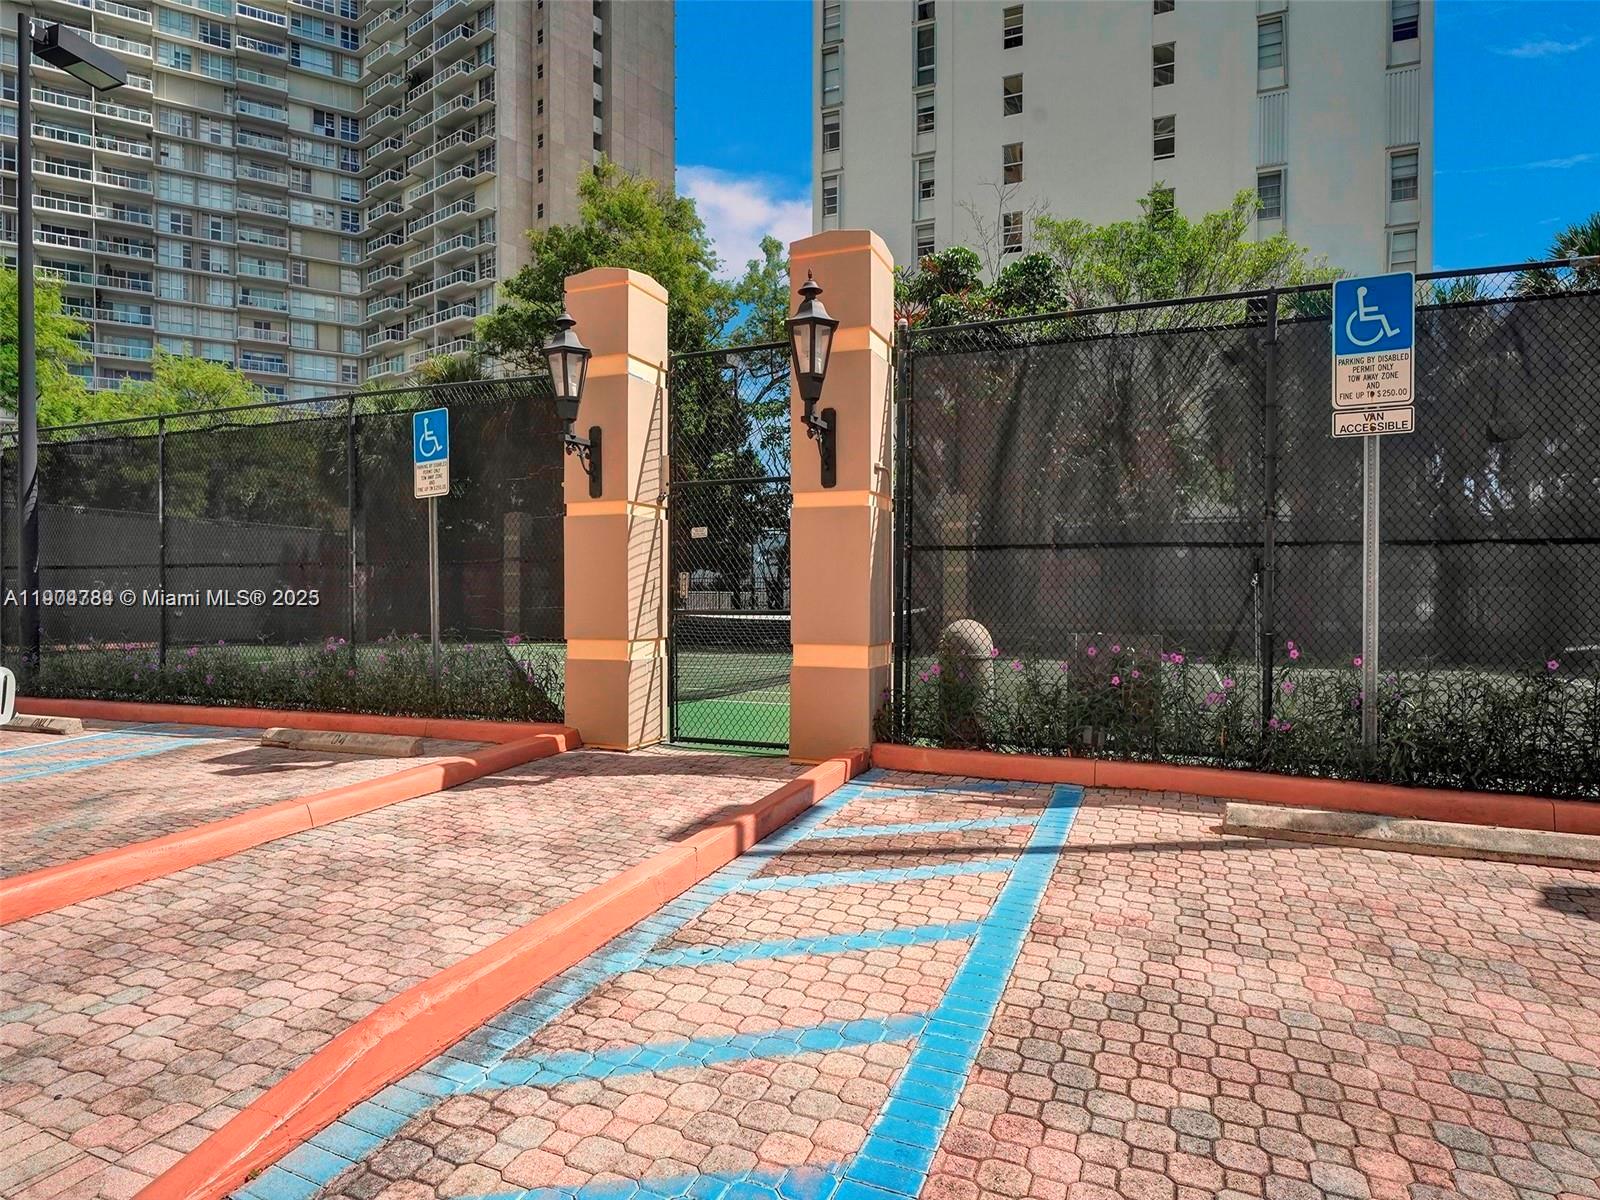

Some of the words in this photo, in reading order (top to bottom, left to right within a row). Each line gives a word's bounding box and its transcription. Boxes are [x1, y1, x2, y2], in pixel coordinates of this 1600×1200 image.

[1338, 357, 1364, 366] PARKING
[1367, 356, 1375, 364] BY
[1377, 352, 1409, 362] DISABLED
[1352, 365, 1375, 373] PERMIT
[1377, 363, 1394, 371] ONLY
[1363, 373, 1378, 381] AWAY
[1381, 371, 1399, 380] ZONE
[1366, 381, 1380, 389] AND
[1339, 392, 1353, 400] FINE
[1356, 391, 1364, 399] UP
[1377, 388, 1407, 397] $250.00
[1363, 412, 1384, 422] VAN
[1340, 420, 1408, 433] ACCESSIBLE
